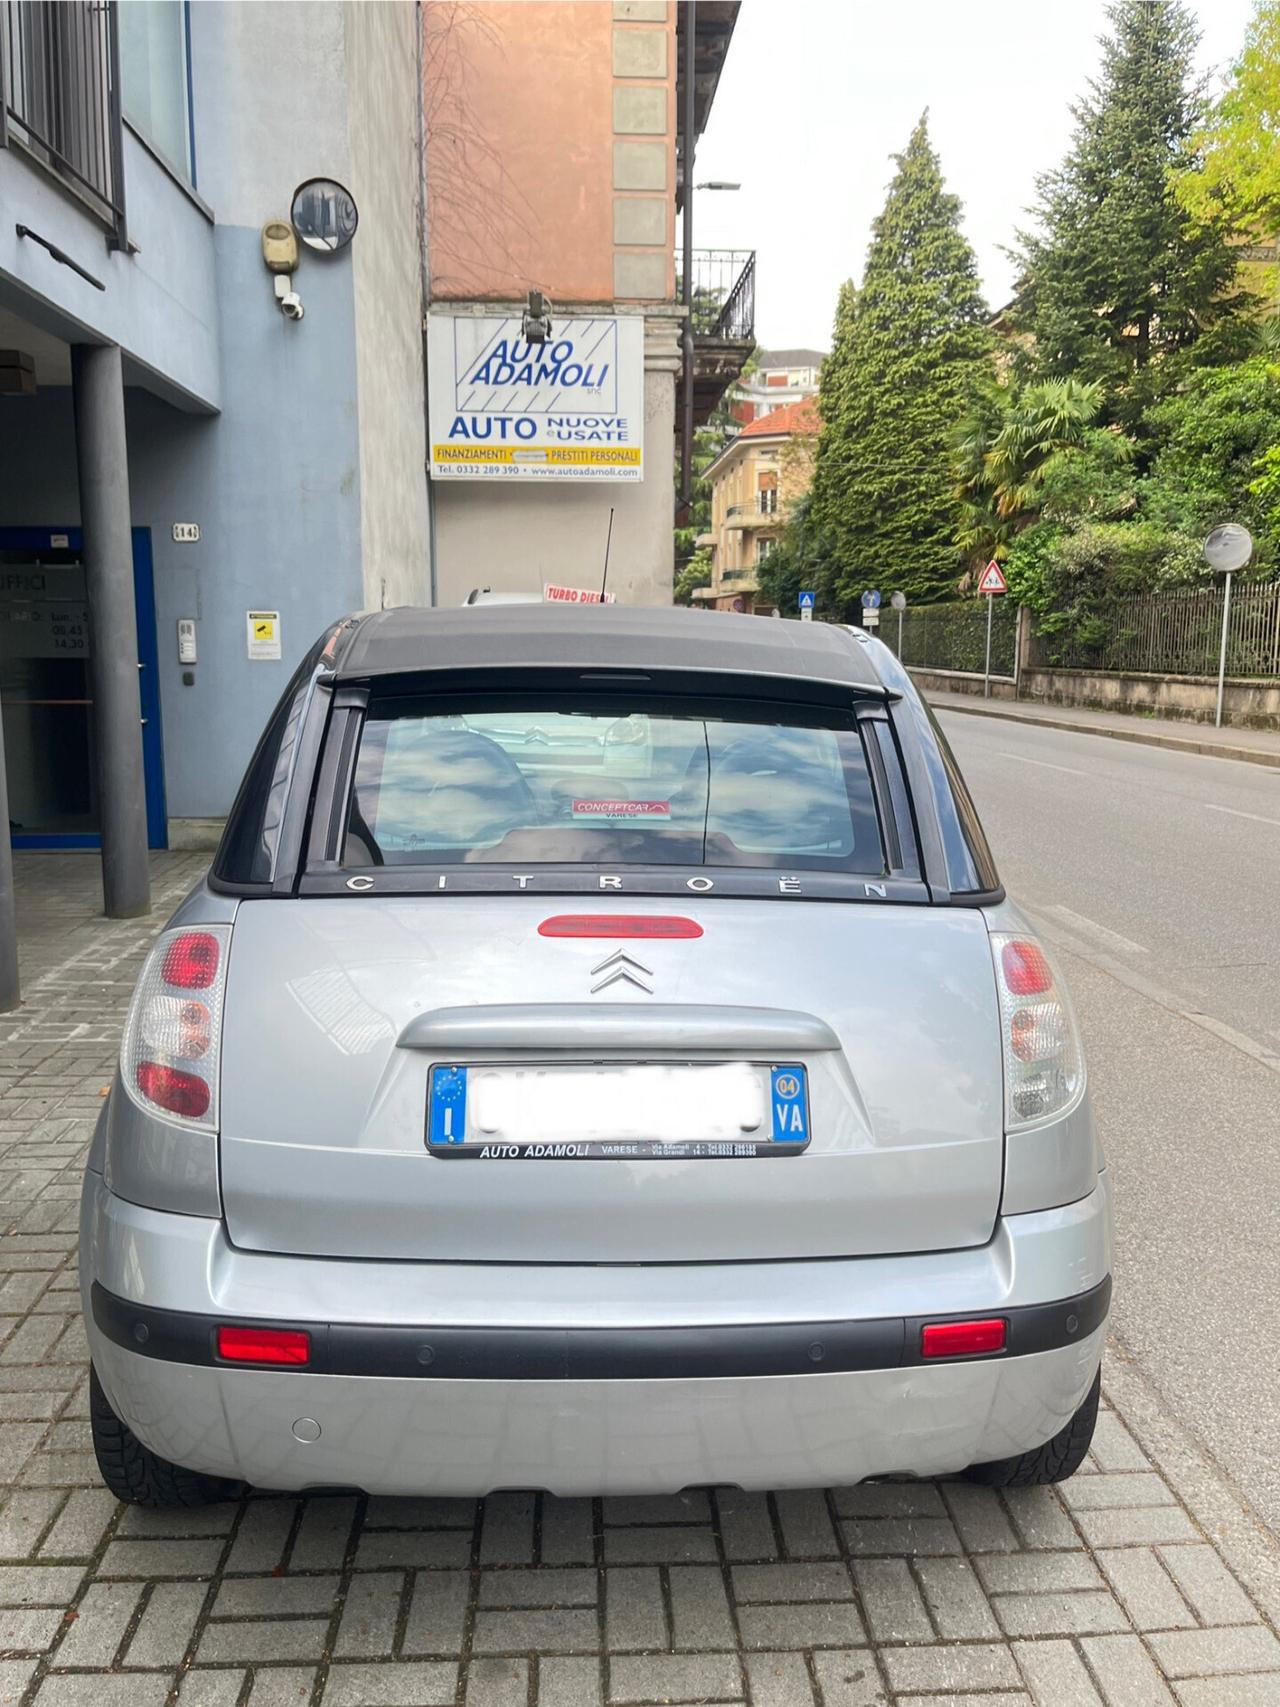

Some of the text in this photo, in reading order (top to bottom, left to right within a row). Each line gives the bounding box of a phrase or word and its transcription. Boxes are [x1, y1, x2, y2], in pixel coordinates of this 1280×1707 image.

[491, 340, 574, 364] AUTO
[469, 362, 610, 387] ADAMOLI
[448, 416, 538, 440] AUTO
[547, 418, 628, 429] NUOVE
[557, 430, 629, 441] USATE
[437, 447, 507, 459] FINANZIAMENTI
[551, 450, 588, 461] PRESTITI
[590, 451, 638, 462] PERSONALI
[438, 464, 638, 477] Tel. 0332 289 390 www.autoadamoli.com
[548, 587, 578, 602] TURBO
[577, 803, 649, 812] CONCEPTCAR
[779, 1079, 796, 1094] 04
[444, 1107, 452, 1136] I
[776, 1104, 804, 1132] VA
[480, 1144, 638, 1158] AUTO ADAMOLI VARESE
